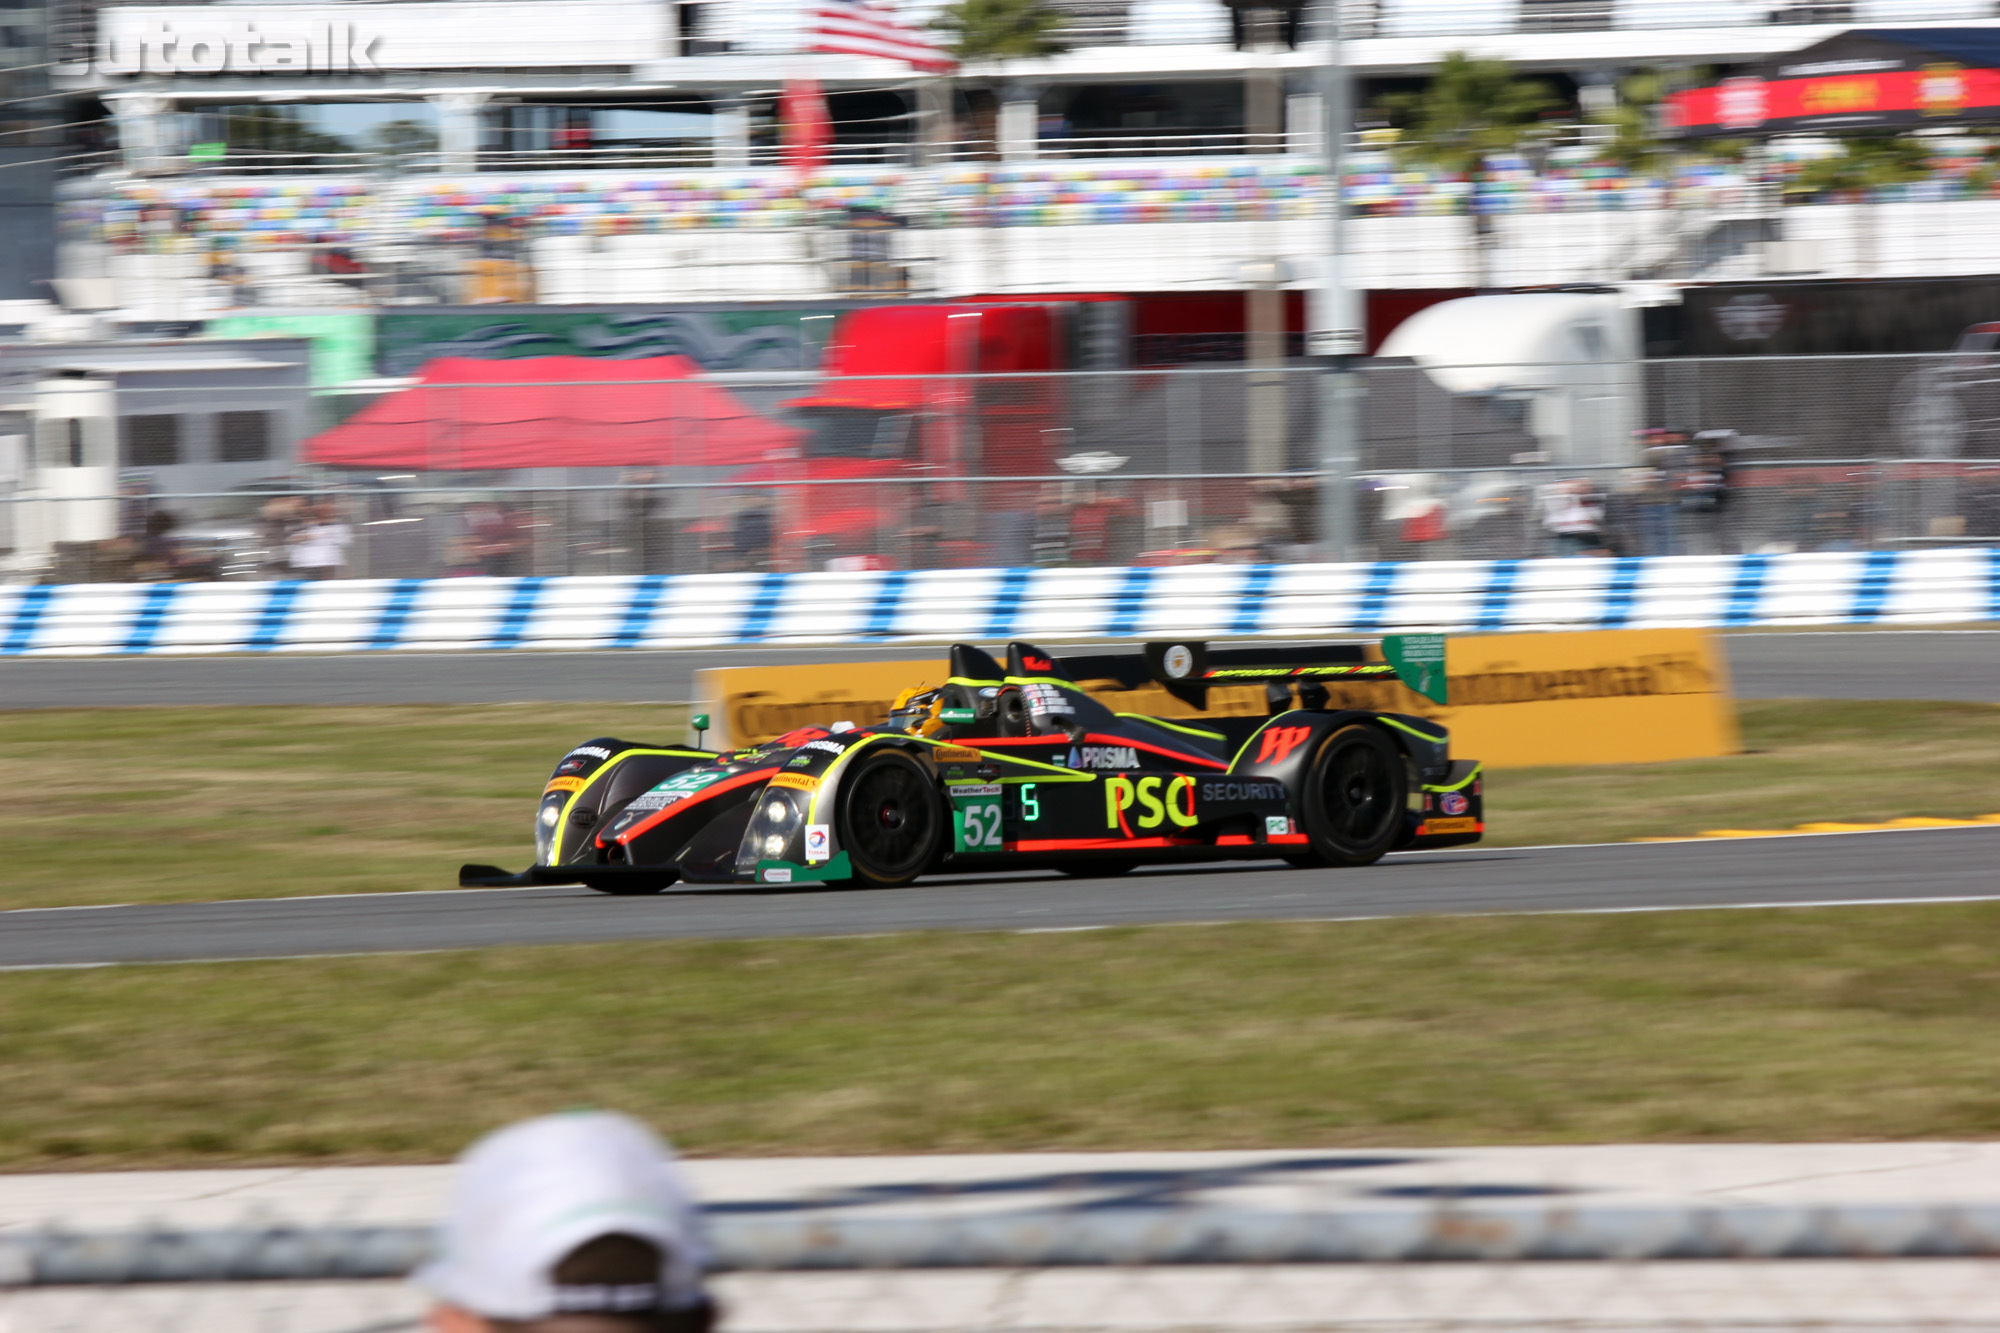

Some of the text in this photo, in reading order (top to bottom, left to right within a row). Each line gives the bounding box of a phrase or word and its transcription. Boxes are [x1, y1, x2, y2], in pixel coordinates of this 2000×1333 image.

[1081, 747, 1140, 768] PRISMA
[659, 773, 718, 790] 52
[952, 785, 1000, 794] WeatherTech
[1203, 783, 1287, 800] SECURITY
[1021, 783, 1039, 820] 5
[1105, 776, 1198, 828] PSC
[964, 804, 1002, 847] 52
